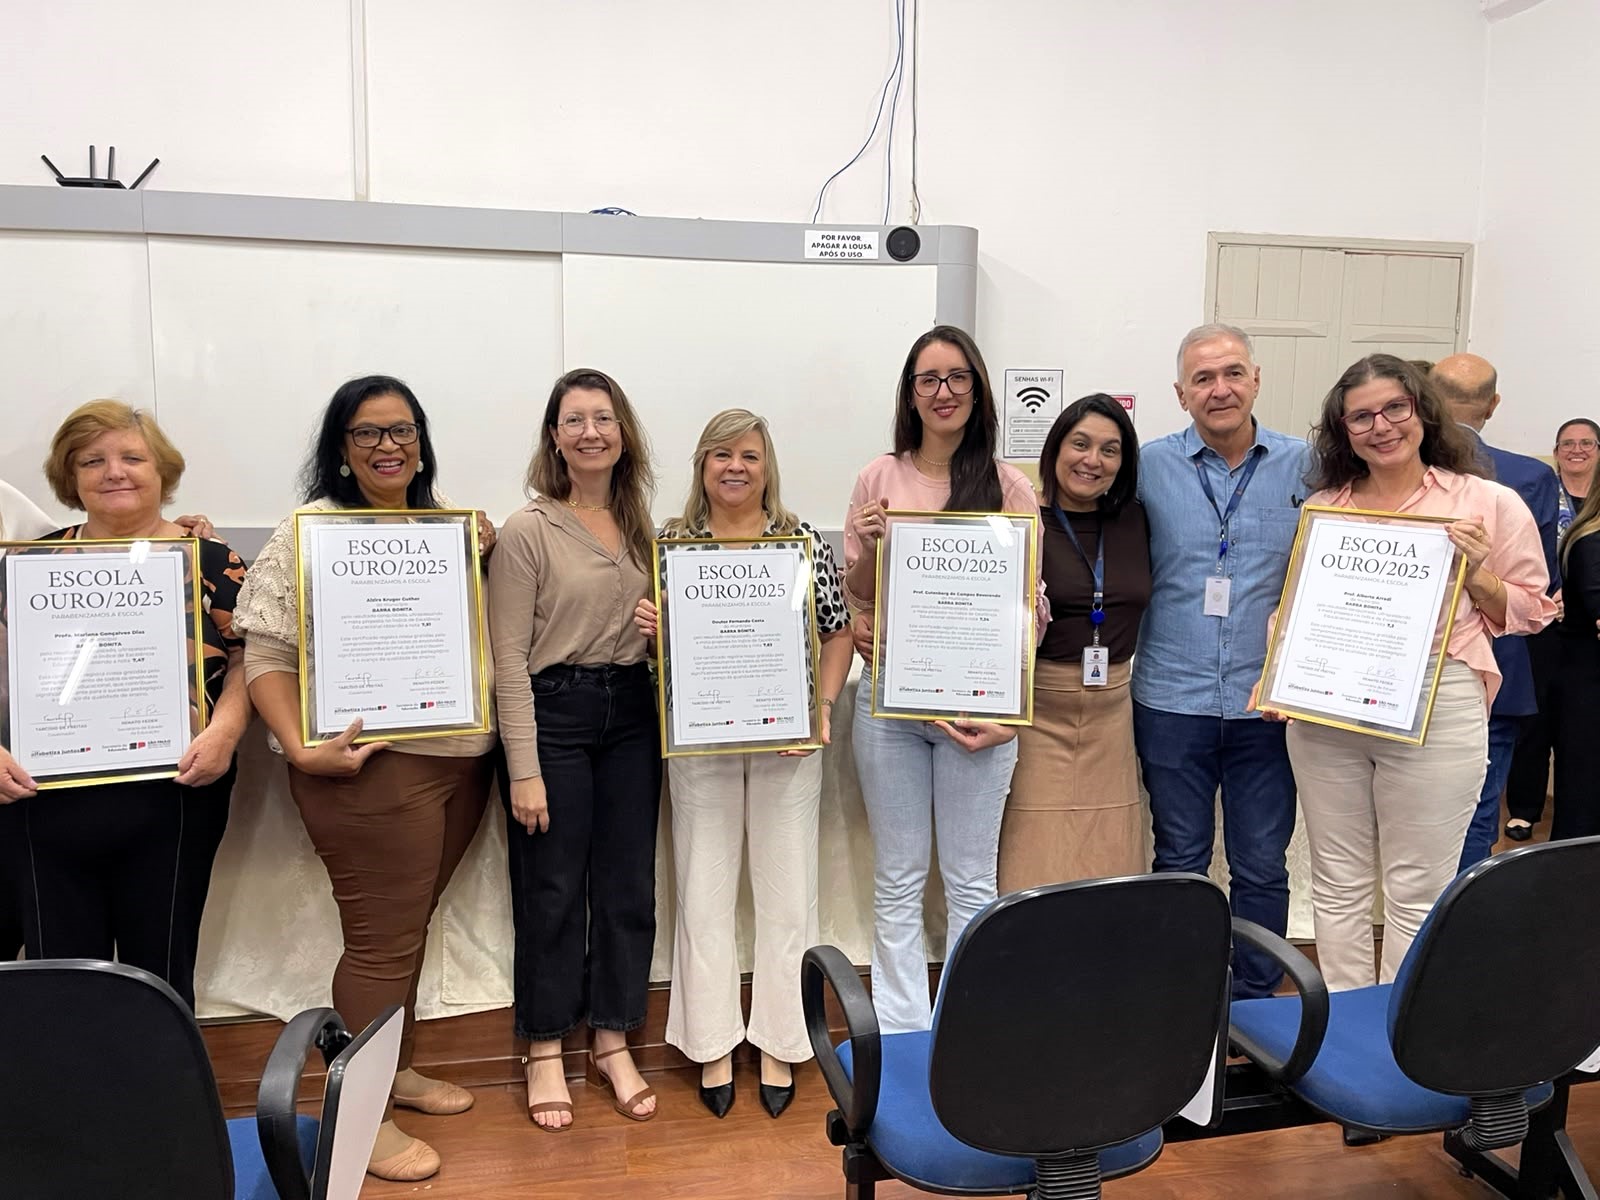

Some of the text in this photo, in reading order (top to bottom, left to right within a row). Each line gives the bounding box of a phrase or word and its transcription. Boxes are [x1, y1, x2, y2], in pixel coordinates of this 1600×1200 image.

[348, 539, 431, 555] ESCOLA
[922, 538, 994, 554] ESCOLA
[1339, 536, 1417, 558] ESCOLA
[332, 560, 448, 576] OURO/2025
[698, 564, 771, 580] ESCOLA
[907, 556, 1007, 574] OURO/2025
[1321, 554, 1430, 580] OURO/2025
[48, 569, 145, 587] ESCOLA
[30, 591, 163, 610] OURO/2025
[685, 584, 786, 600] OURO/2025
